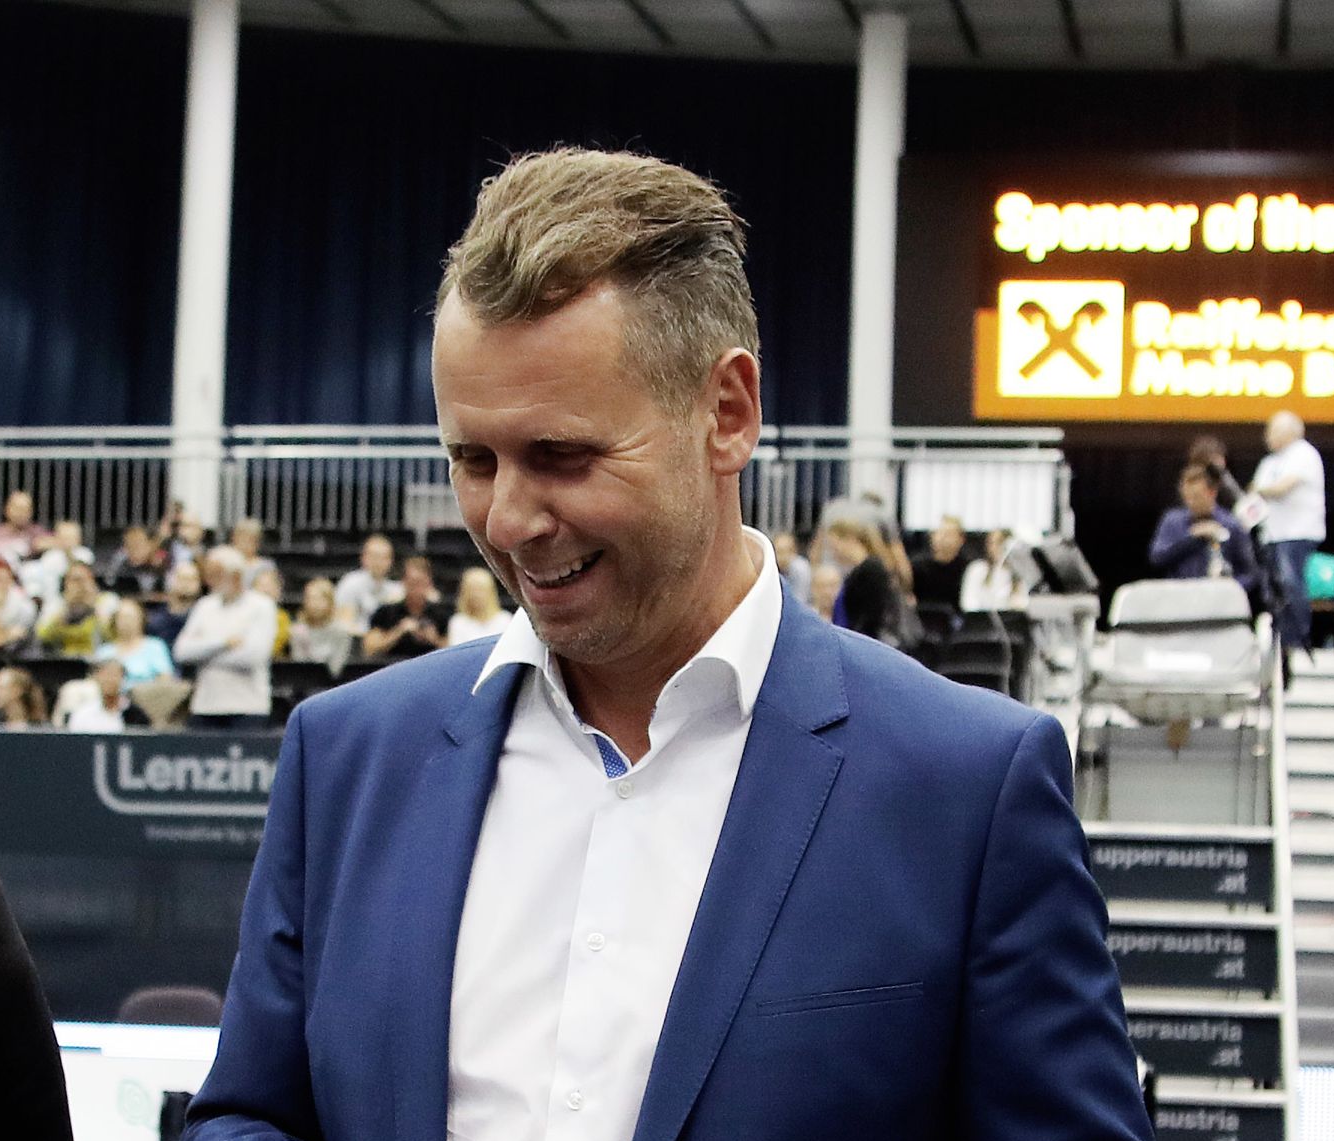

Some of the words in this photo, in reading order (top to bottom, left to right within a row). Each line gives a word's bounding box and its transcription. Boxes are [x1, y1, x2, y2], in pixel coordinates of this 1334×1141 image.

[995, 191, 1199, 262] Sponsor
[1202, 193, 1258, 253] of
[1129, 349, 1294, 397] Meine
[119, 743, 277, 793] Lenzin
[1105, 932, 1246, 956] pperaustria
[1155, 1110, 1240, 1131] austria
